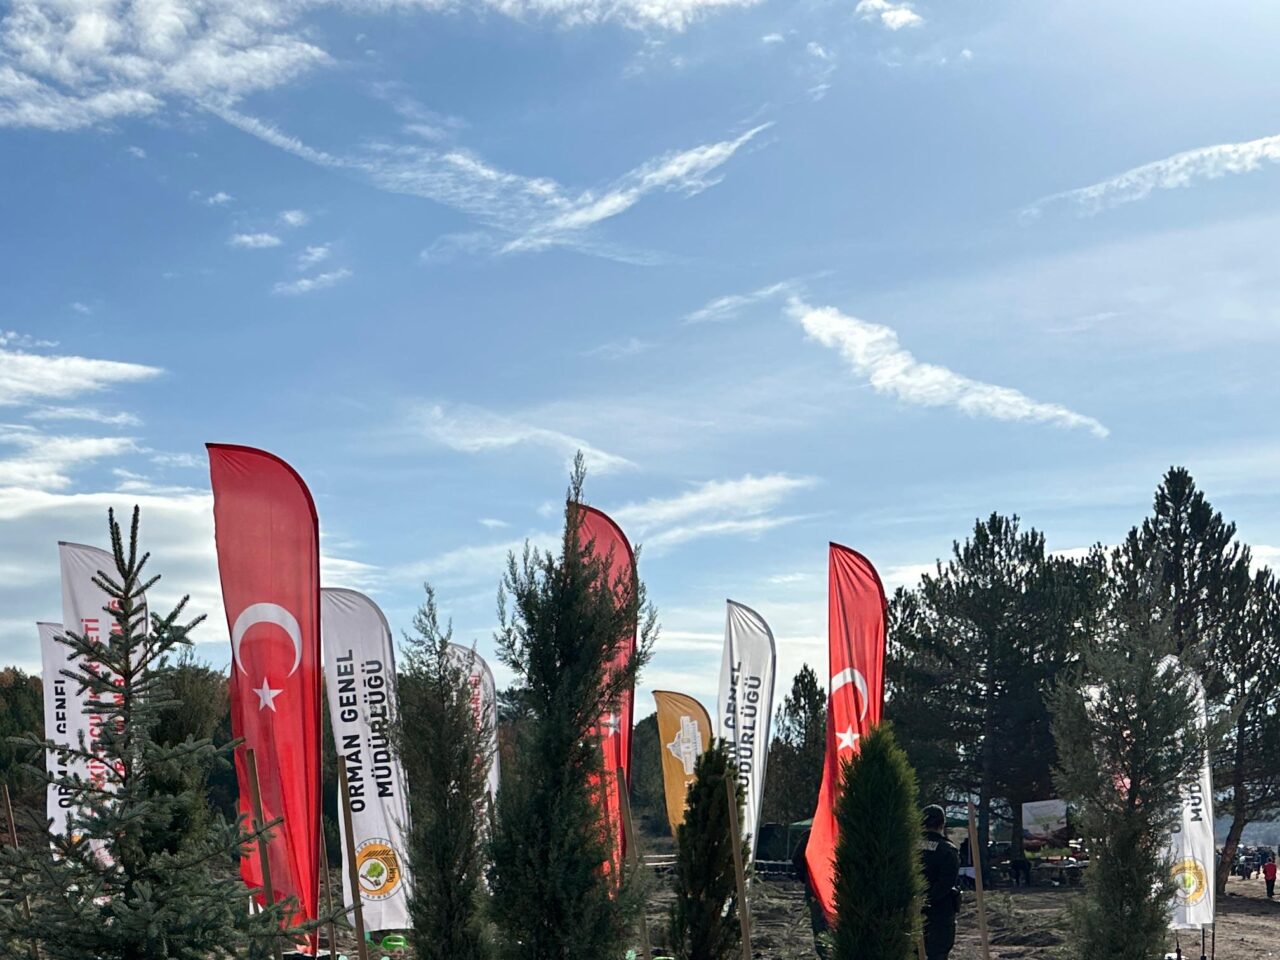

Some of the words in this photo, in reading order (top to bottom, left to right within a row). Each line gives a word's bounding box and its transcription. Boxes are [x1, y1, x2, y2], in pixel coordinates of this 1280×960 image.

[336, 649, 359, 723] GENEL
[361, 659, 394, 798] MÜDÜRLÜĞÜ
[342, 734, 366, 813] ORMAN
